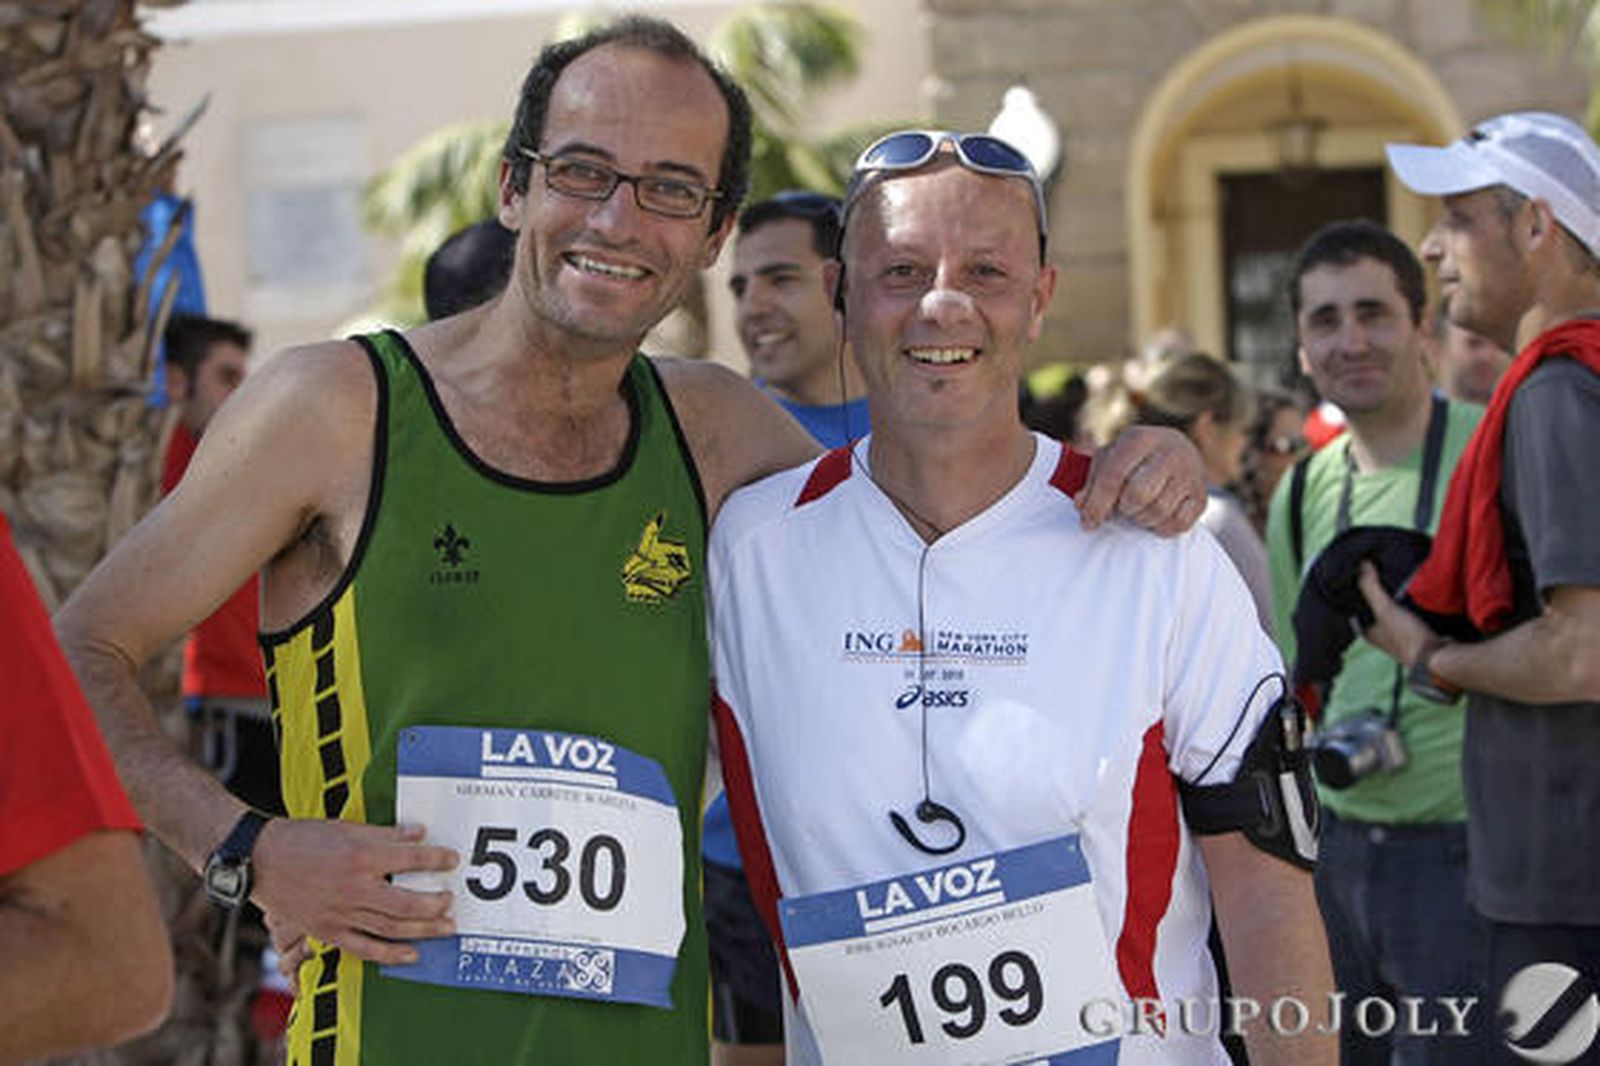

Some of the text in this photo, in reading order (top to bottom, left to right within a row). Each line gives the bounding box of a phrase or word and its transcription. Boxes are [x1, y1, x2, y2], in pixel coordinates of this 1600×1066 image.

[844, 632, 893, 651] ING
[937, 640, 1027, 655] MARATHON
[482, 732, 617, 773] LA VOZ
[465, 826, 626, 912] 530
[856, 859, 1001, 918] LA VOZ
[458, 953, 575, 983] PLAZA
[879, 950, 1044, 1045] 199
